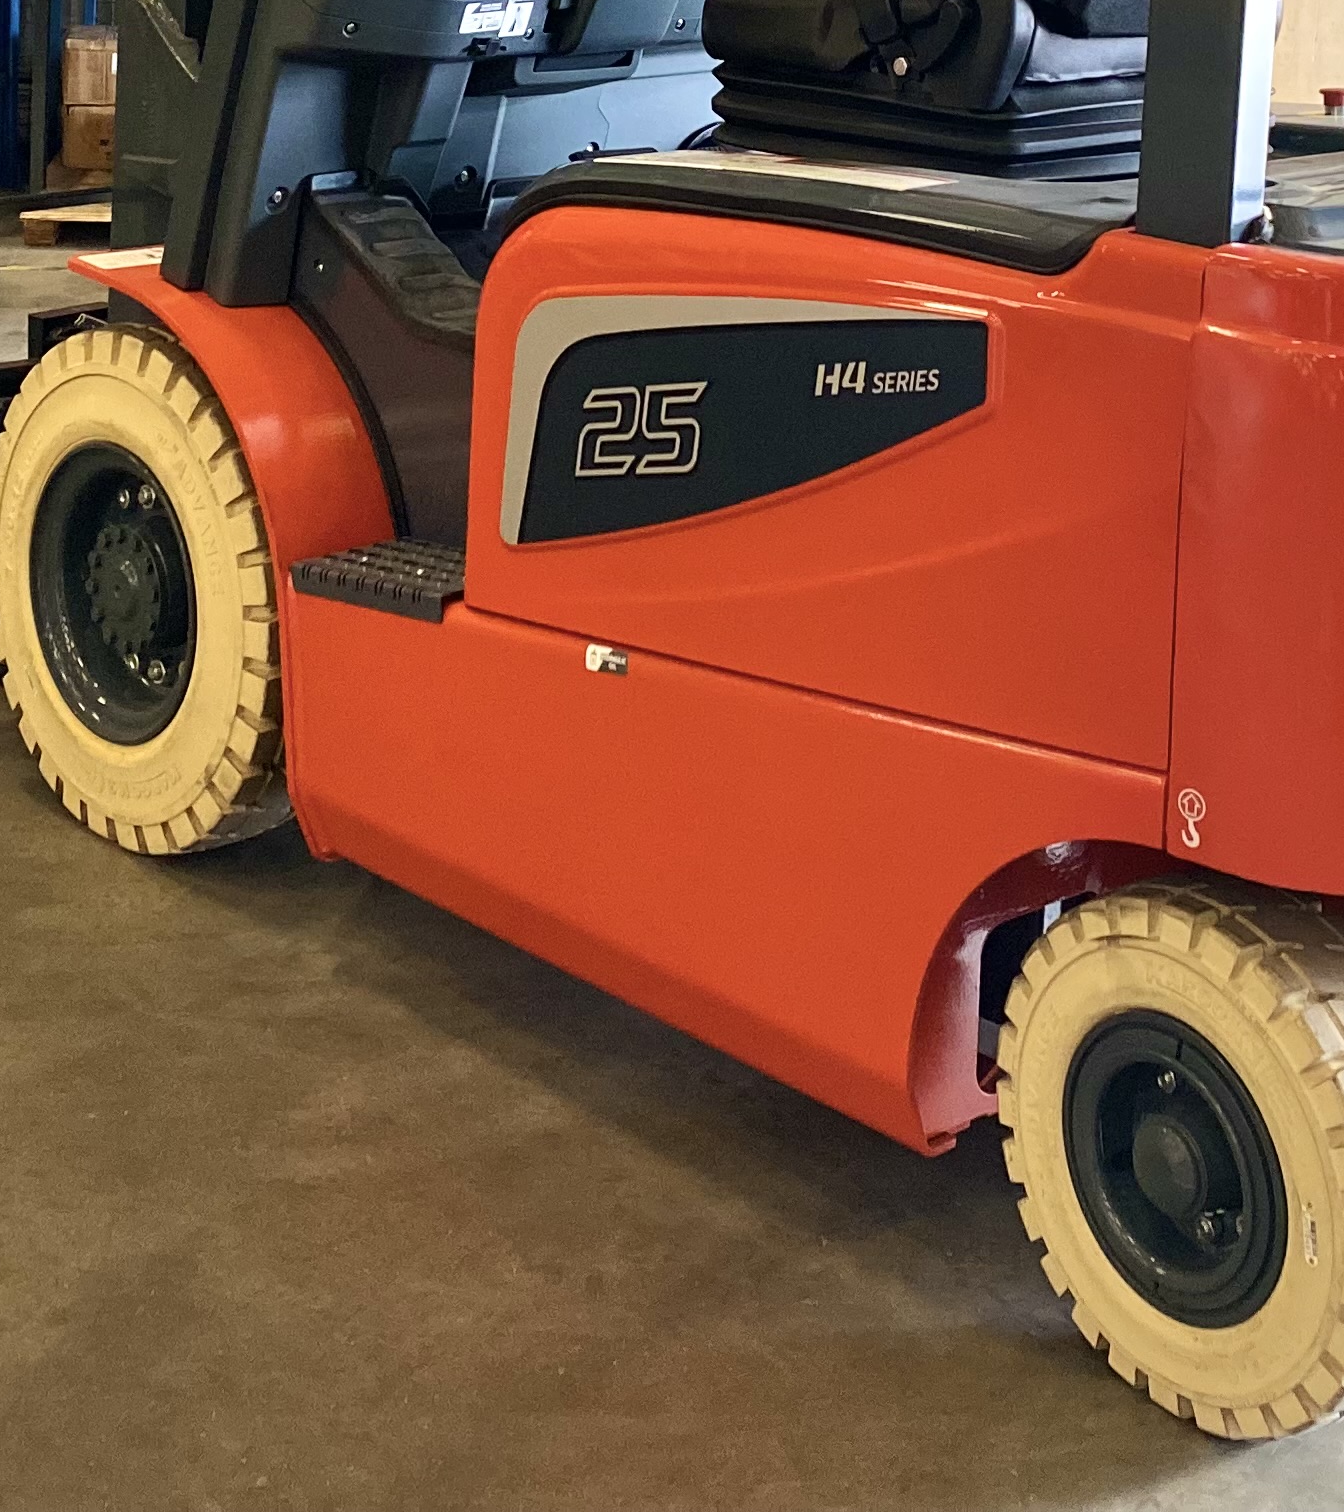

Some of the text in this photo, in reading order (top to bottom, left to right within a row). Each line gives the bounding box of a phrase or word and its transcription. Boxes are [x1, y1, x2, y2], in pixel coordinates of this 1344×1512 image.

[814, 361, 940, 397] H4 SERIES
[575, 381, 709, 477] 25
